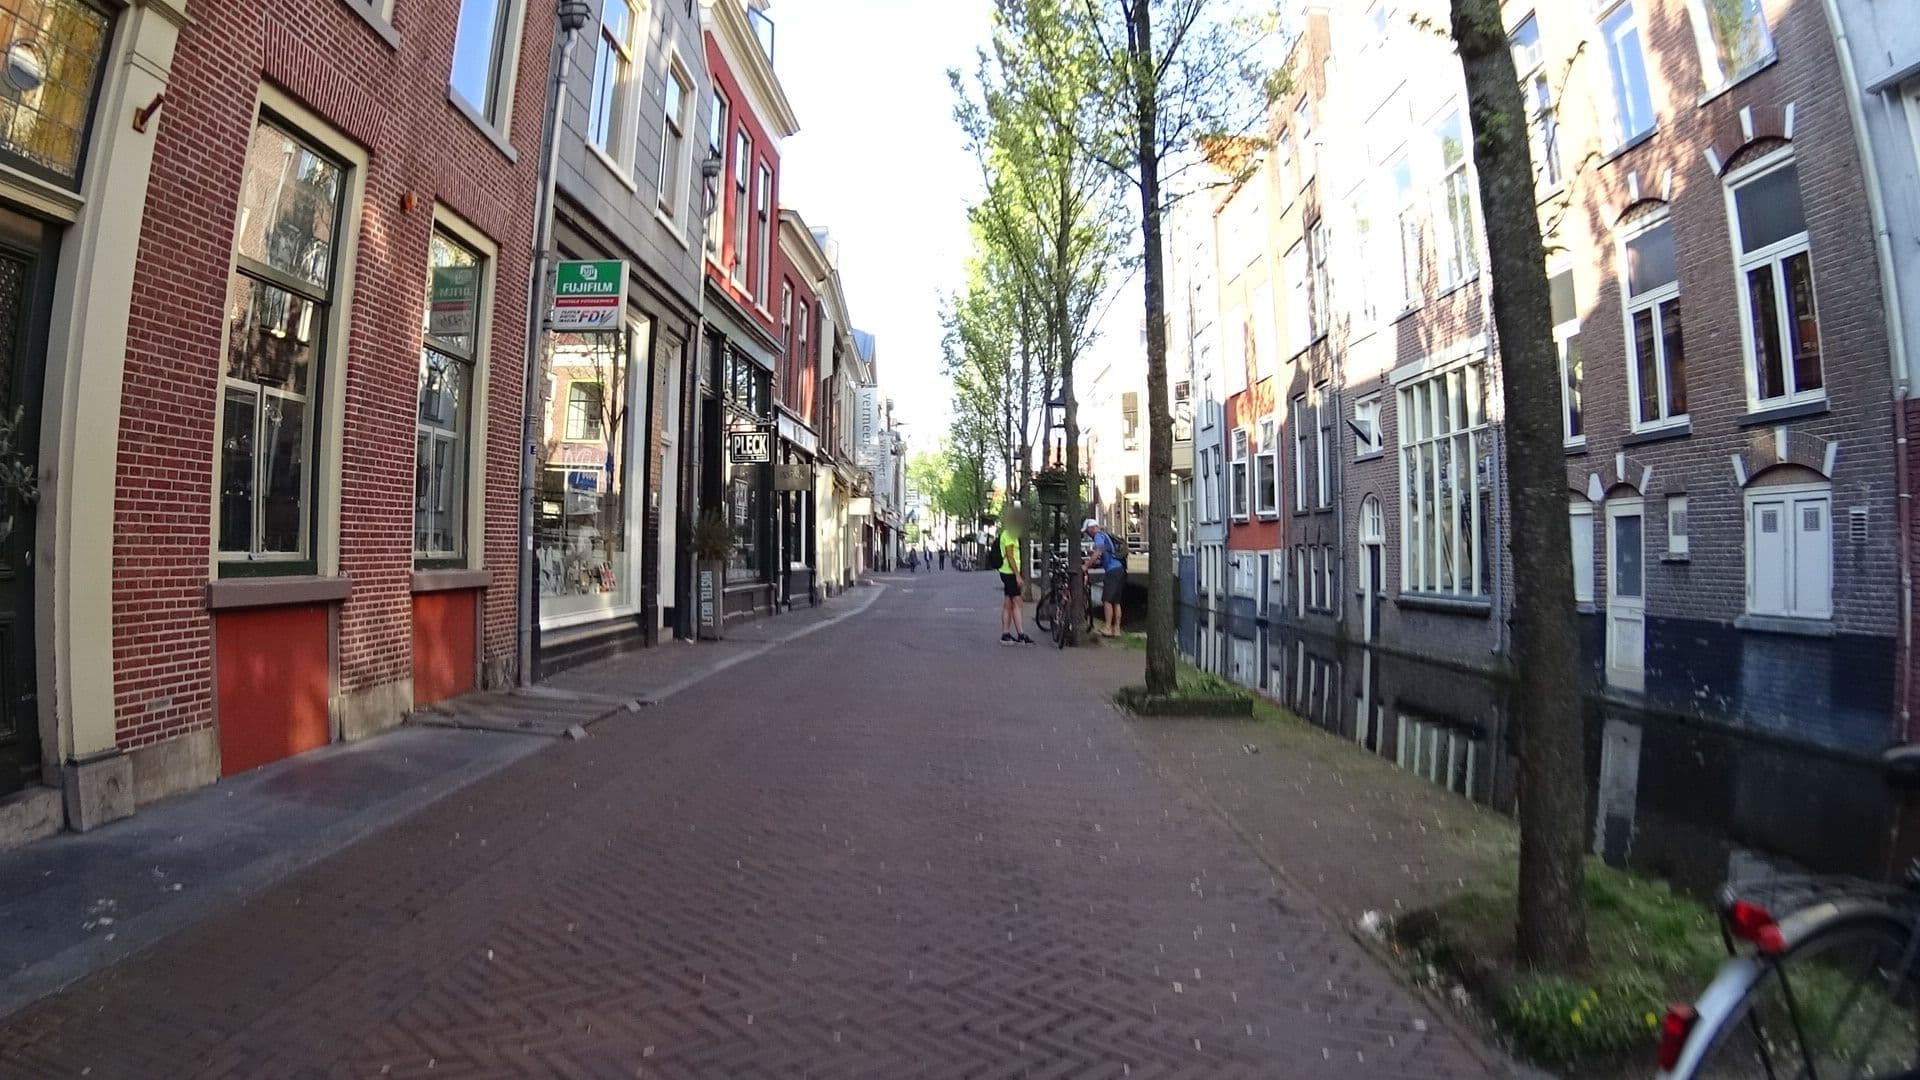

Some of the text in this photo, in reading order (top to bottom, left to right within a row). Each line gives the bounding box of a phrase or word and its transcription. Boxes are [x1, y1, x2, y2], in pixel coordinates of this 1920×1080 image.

[562, 282, 613, 293] FUJIFILM
[734, 435, 767, 454] PLECK
[701, 571, 713, 627] HOSTEL DELFT
